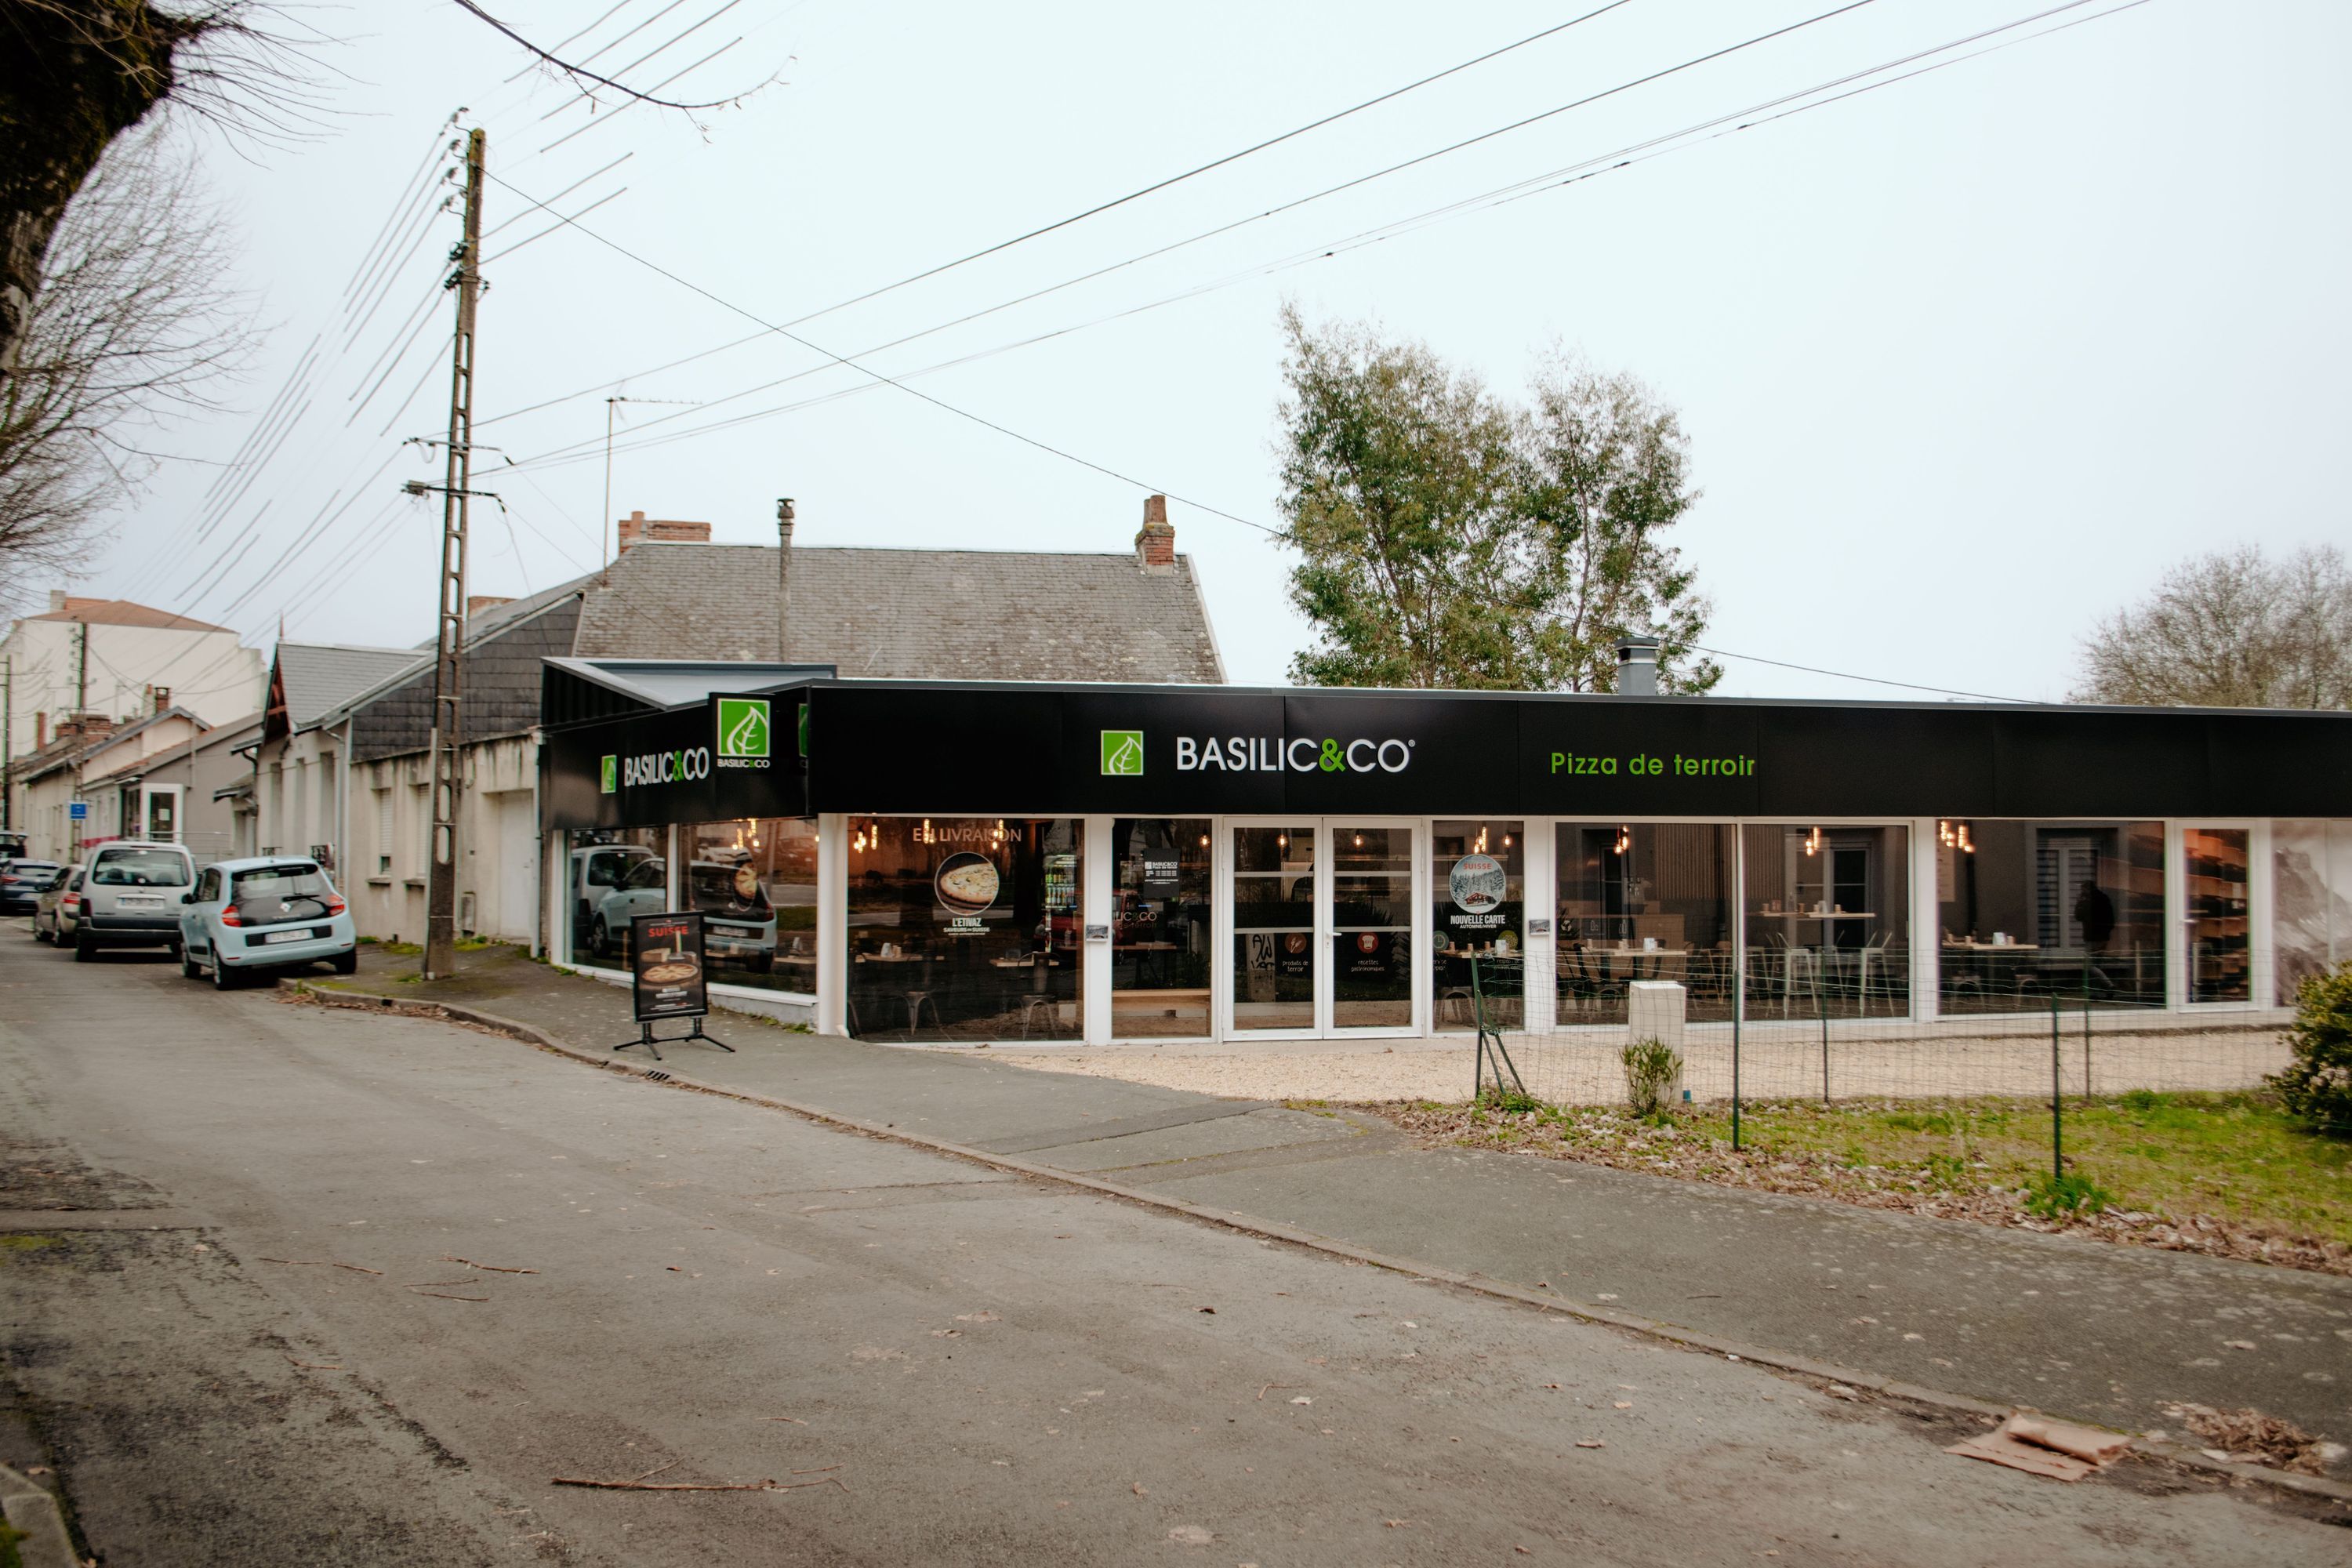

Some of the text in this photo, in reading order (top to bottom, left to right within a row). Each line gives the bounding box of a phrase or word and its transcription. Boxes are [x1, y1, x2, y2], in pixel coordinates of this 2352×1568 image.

[623, 746, 710, 787] BASILIC&CO
[717, 758, 771, 768] BASILIC&CO
[1550, 752, 1755, 776] Pizza de terroir
[1450, 914, 1505, 924] NOUVELLE CARTE
